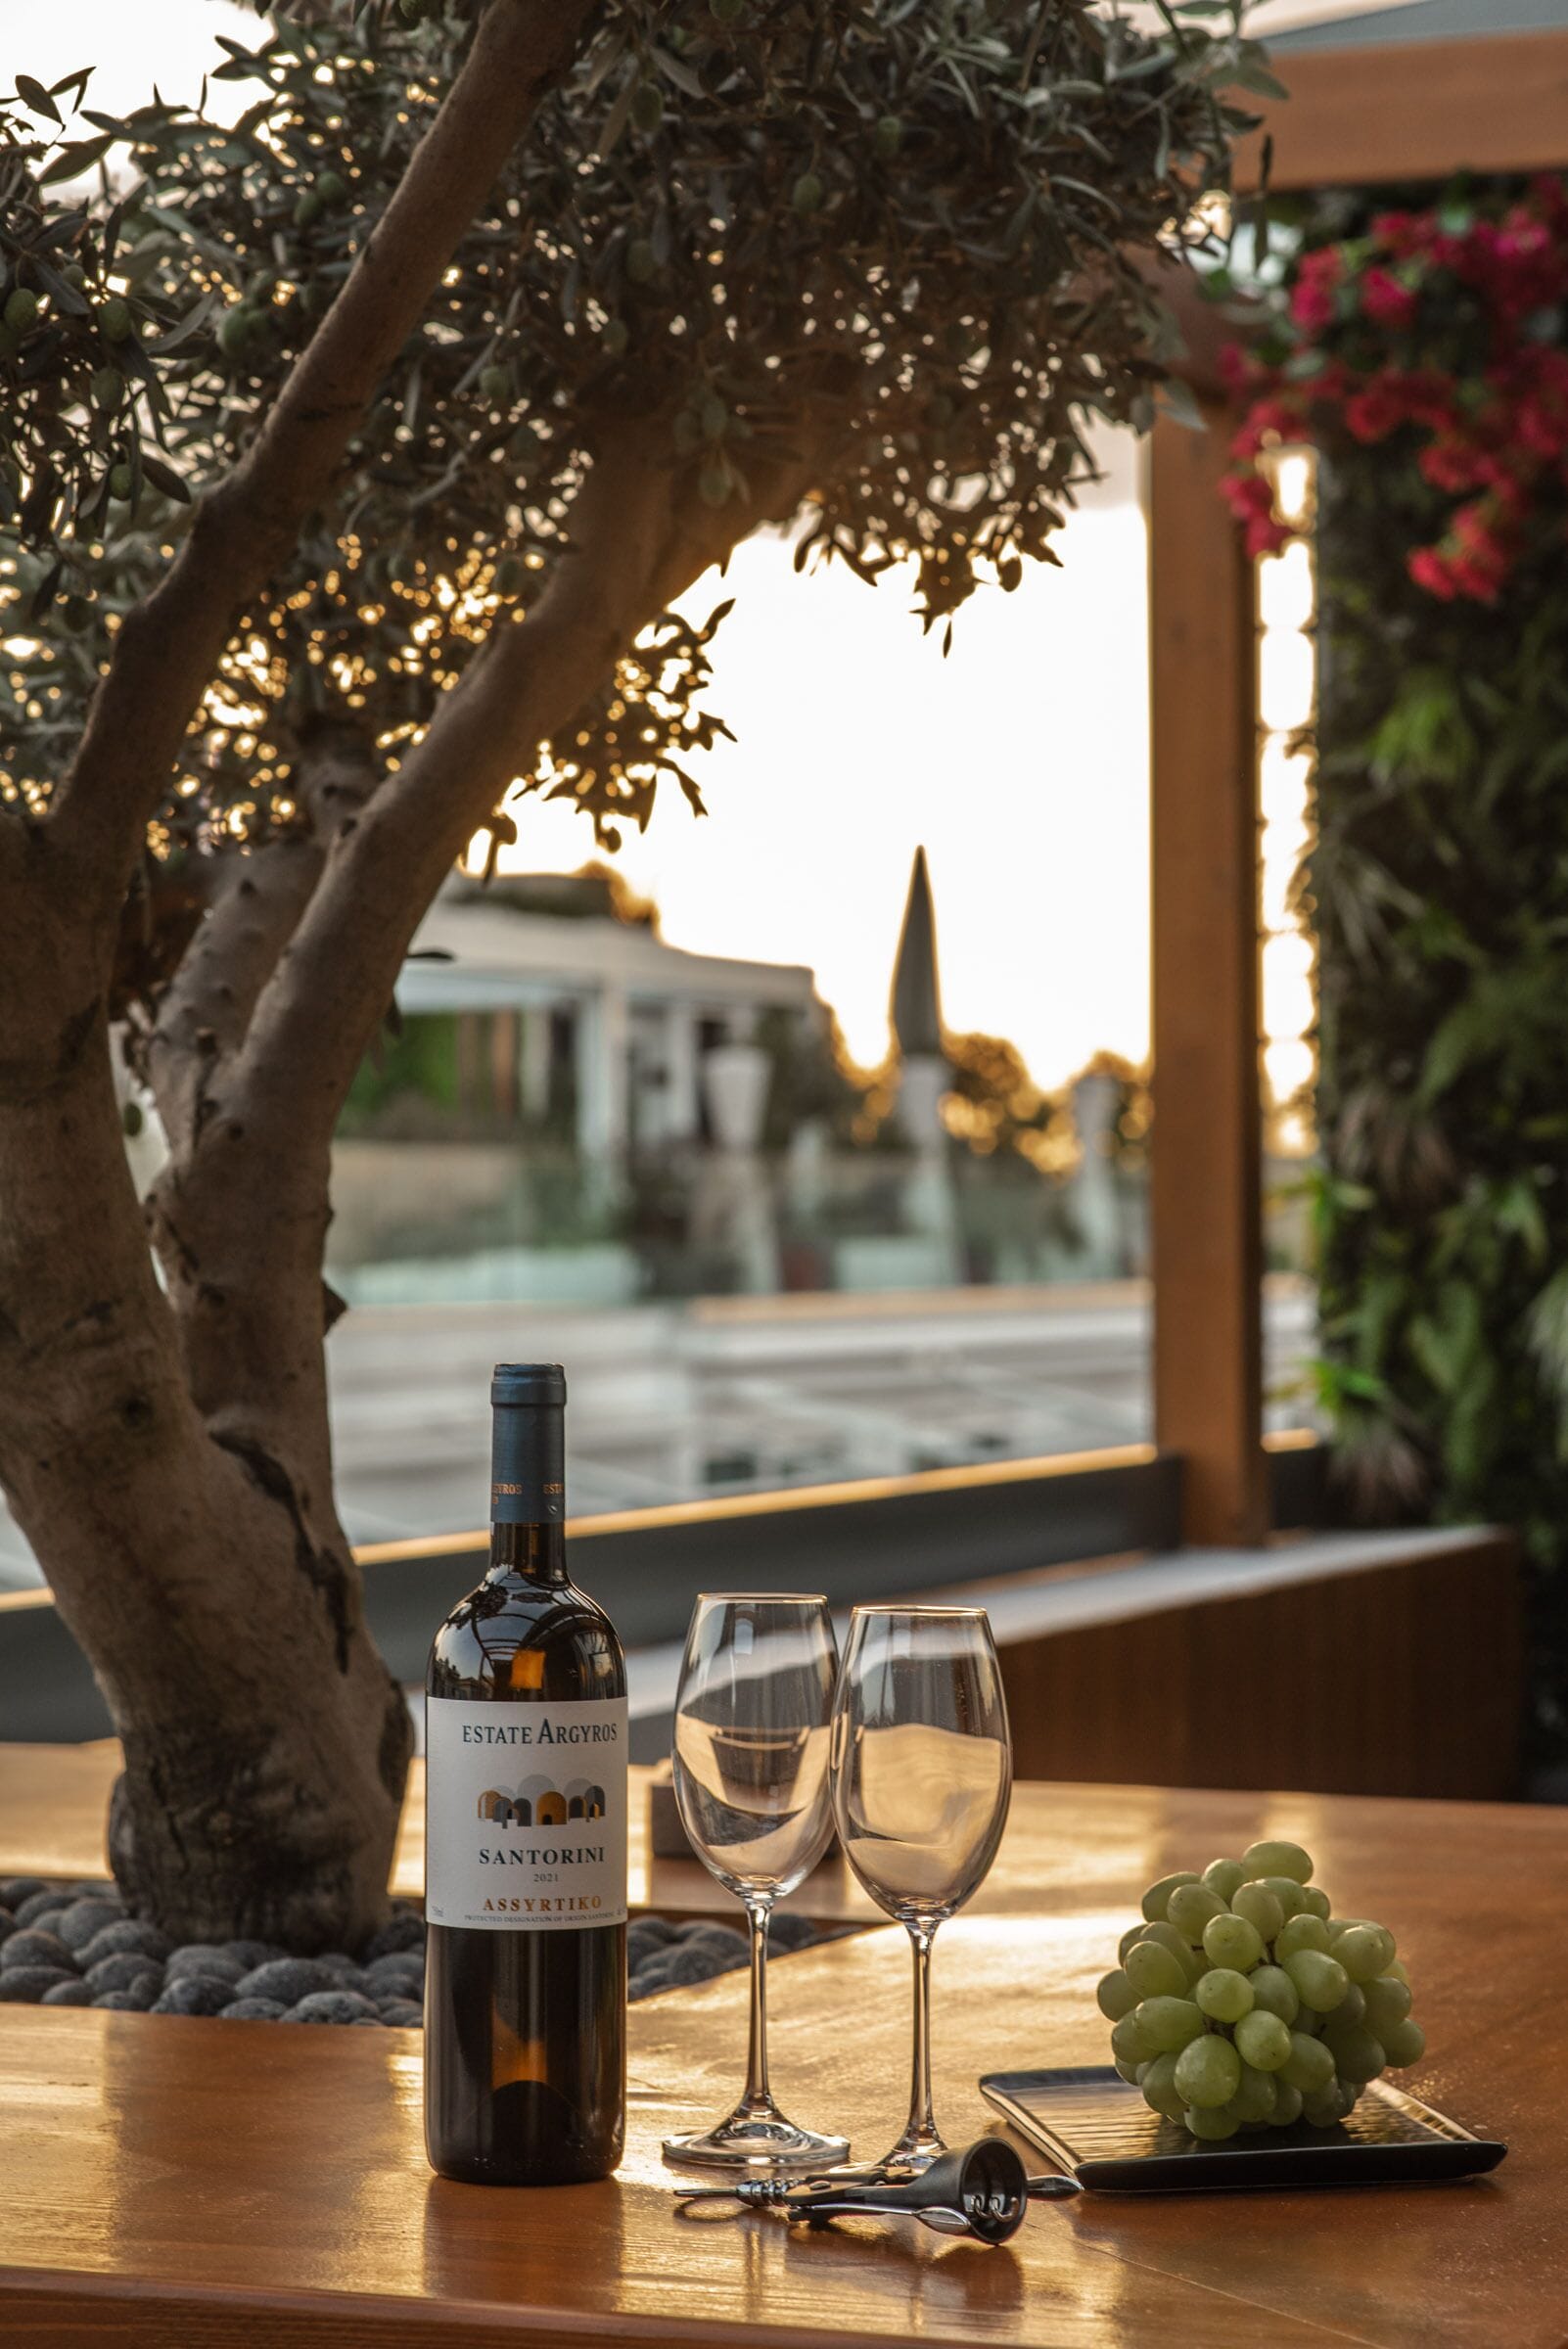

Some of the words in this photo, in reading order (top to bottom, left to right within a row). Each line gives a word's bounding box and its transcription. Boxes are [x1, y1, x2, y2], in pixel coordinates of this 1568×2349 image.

[462, 1726, 532, 1744] ESTATE
[537, 1718, 618, 1744] ARGYROS
[479, 1847, 605, 1865] SANTORINI
[533, 1873, 560, 1883] 2021
[483, 1896, 602, 1911] ASSYRTIKO
